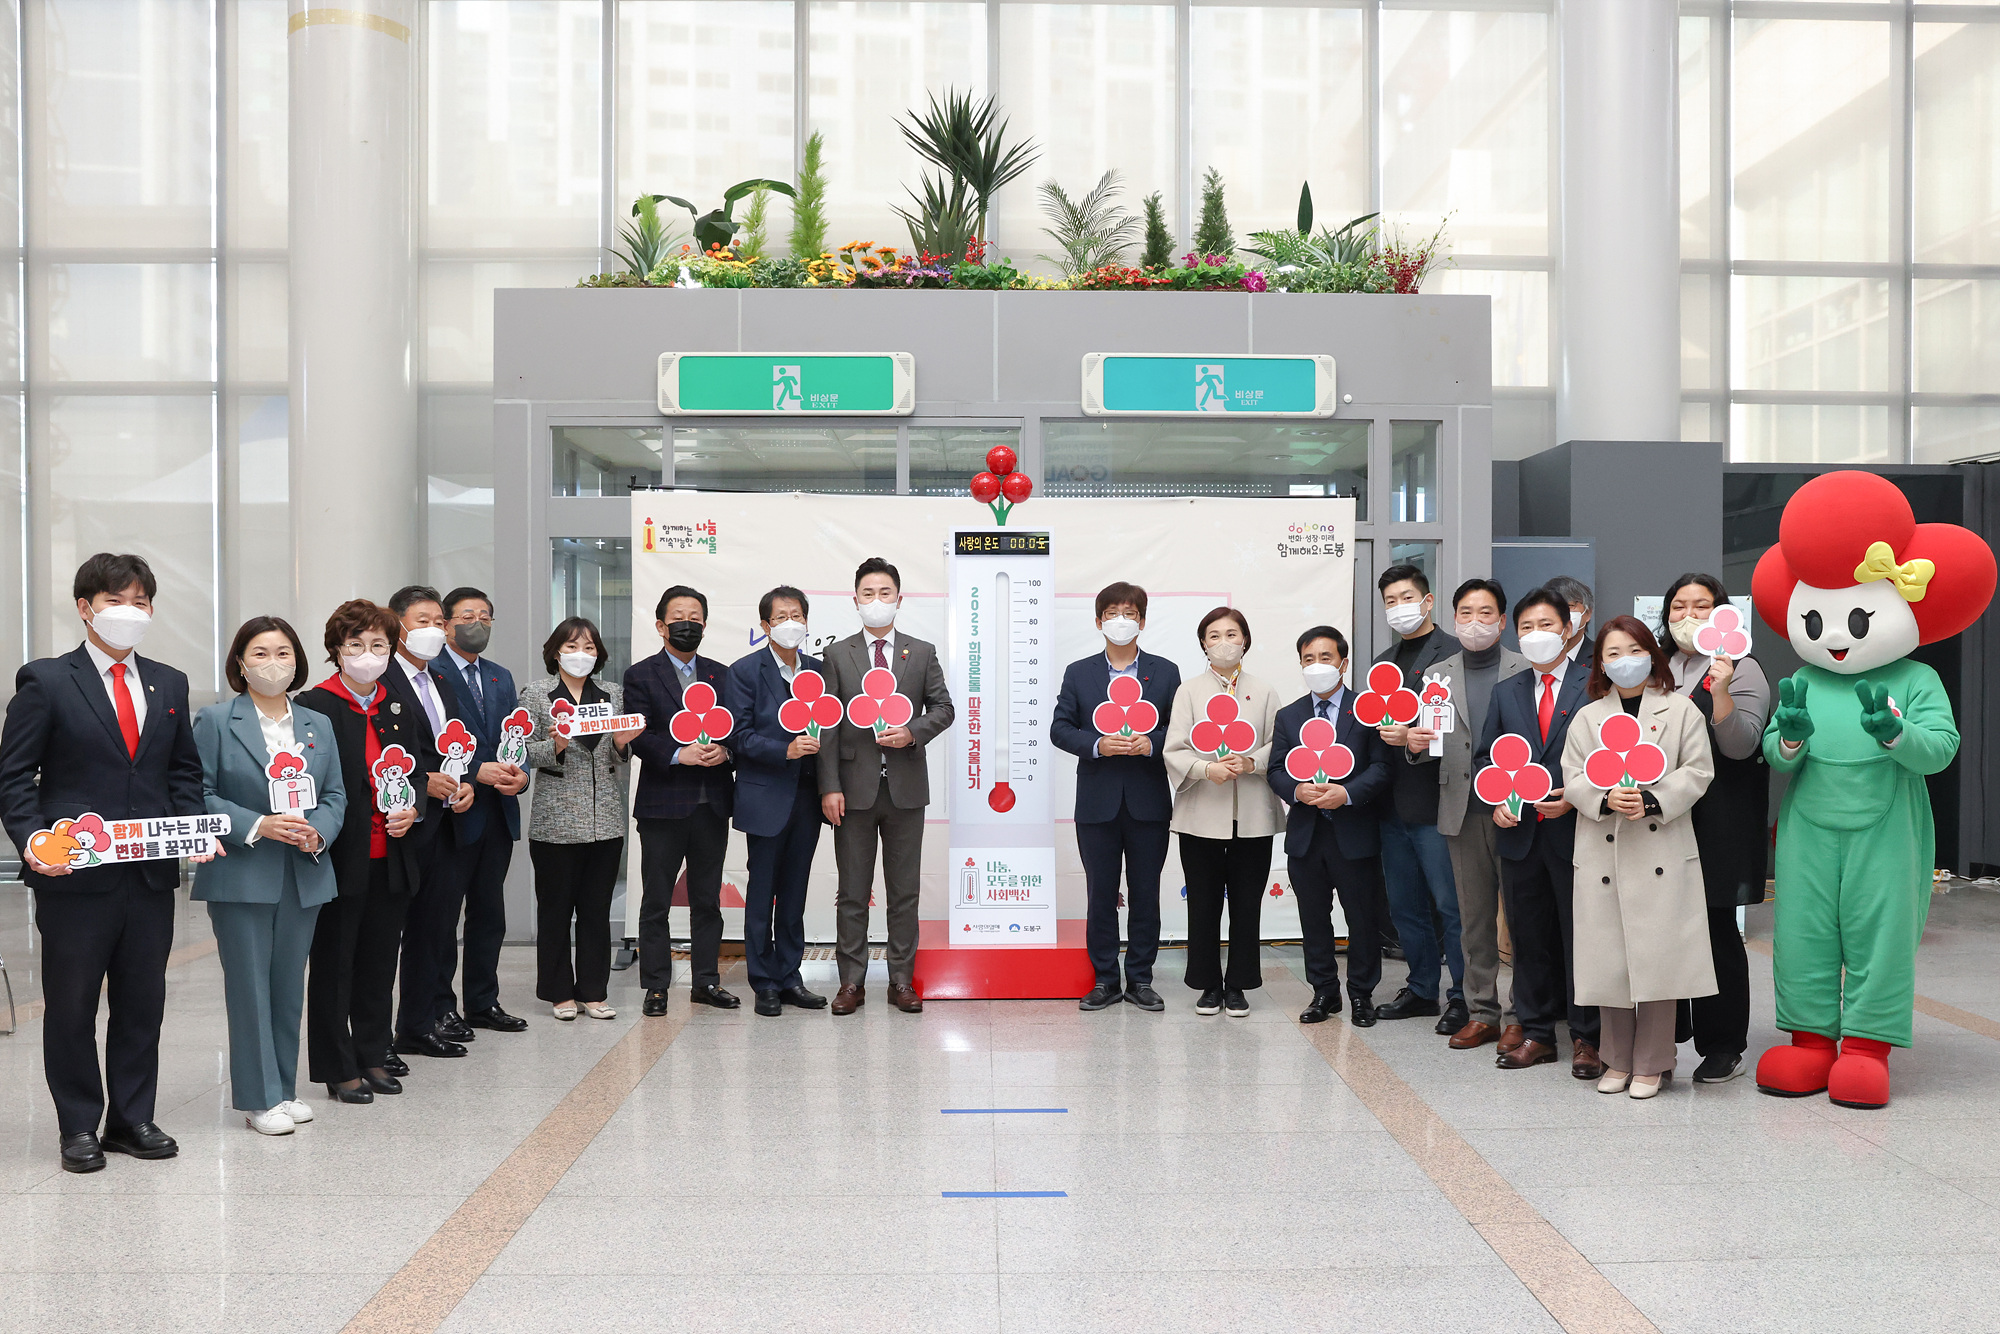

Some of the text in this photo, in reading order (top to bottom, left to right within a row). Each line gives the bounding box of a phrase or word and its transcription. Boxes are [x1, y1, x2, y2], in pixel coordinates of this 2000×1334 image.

[810, 393, 839, 402] 비상문
[1235, 390, 1264, 399] 비상문
[662, 519, 717, 536] 함께하는 나눔
[659, 536, 717, 554] 지속가능한 서울
[959, 536, 982, 551] 사랑의
[984, 536, 999, 551] 온도
[1323, 542, 1345, 557] 도봉
[968, 587, 981, 790] 2023 희망온돌 따뜻한 겨울나기
[1028, 698, 1038, 706] 40
[578, 705, 609, 718] 우리는
[579, 716, 640, 733] 체인지메이커
[112, 817, 228, 839] 함께 나누는 세상,
[115, 838, 209, 860] 변화를 꿈꾸다
[986, 875, 1042, 887] 모두를 위한
[986, 889, 1030, 901] 사회백신
[1023, 925, 1041, 933] 도봉구
